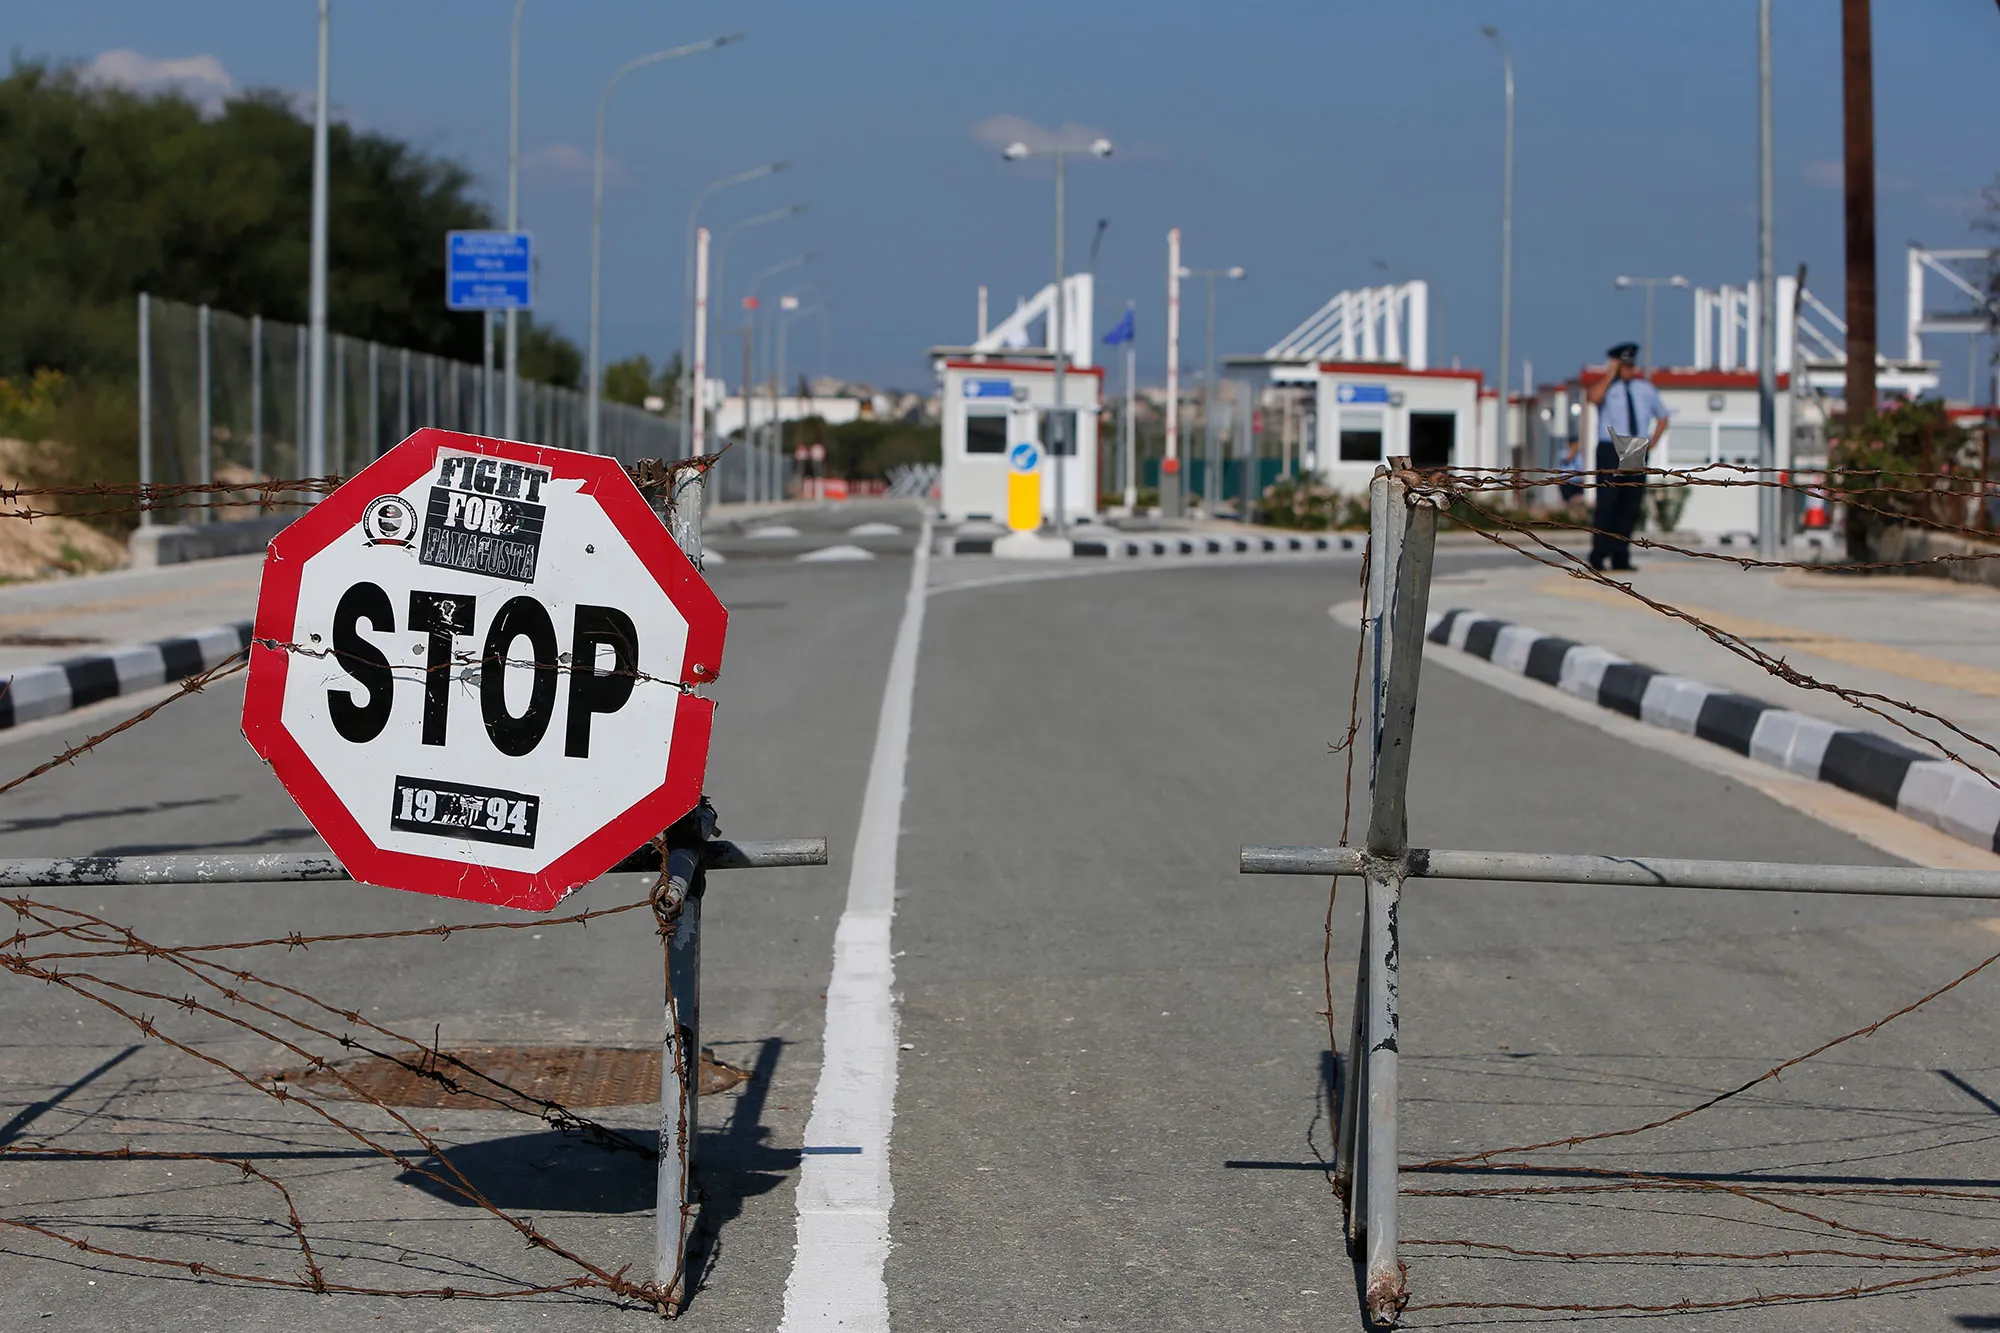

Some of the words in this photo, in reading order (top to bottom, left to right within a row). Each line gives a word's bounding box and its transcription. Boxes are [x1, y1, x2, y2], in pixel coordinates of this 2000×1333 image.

[437, 456, 549, 503] FIGHT
[444, 491, 503, 536] FOR
[424, 527, 535, 579] FAMAGUSTA
[326, 581, 639, 759] STOP
